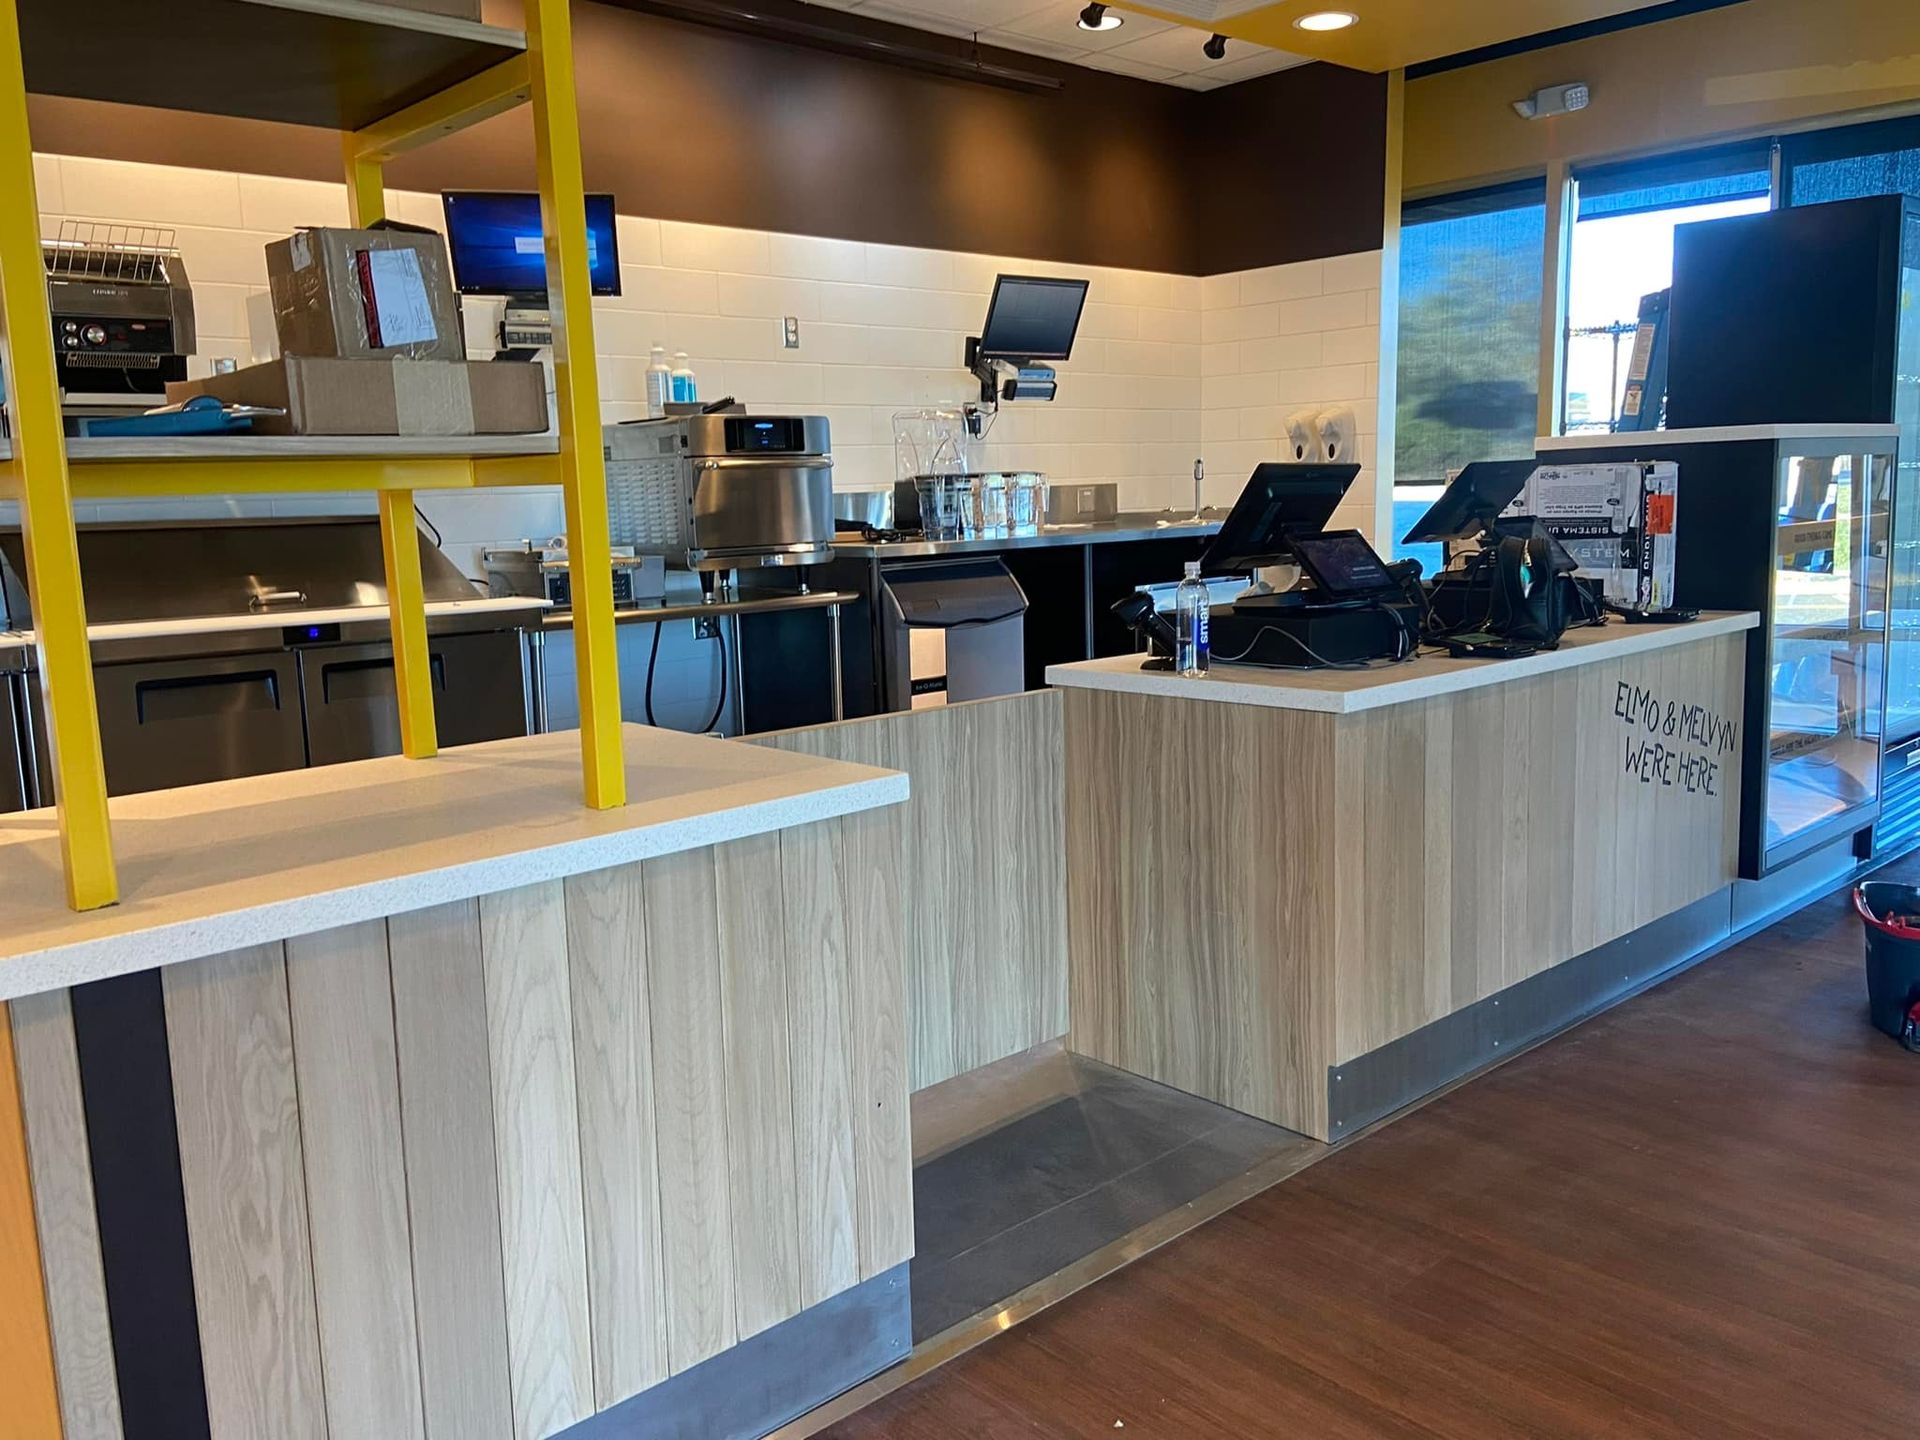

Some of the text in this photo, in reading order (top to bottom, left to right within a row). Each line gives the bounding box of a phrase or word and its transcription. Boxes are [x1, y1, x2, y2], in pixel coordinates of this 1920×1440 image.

[1563, 526, 1609, 534] SISTEMA
[1571, 548, 1630, 558] YSTEM
[1199, 600, 1209, 644] smart
[1615, 681, 1660, 733] ELMO
[1662, 701, 1676, 736] &
[1679, 704, 1738, 756] MELVYN
[1625, 736, 1718, 797] WERE HERE.
